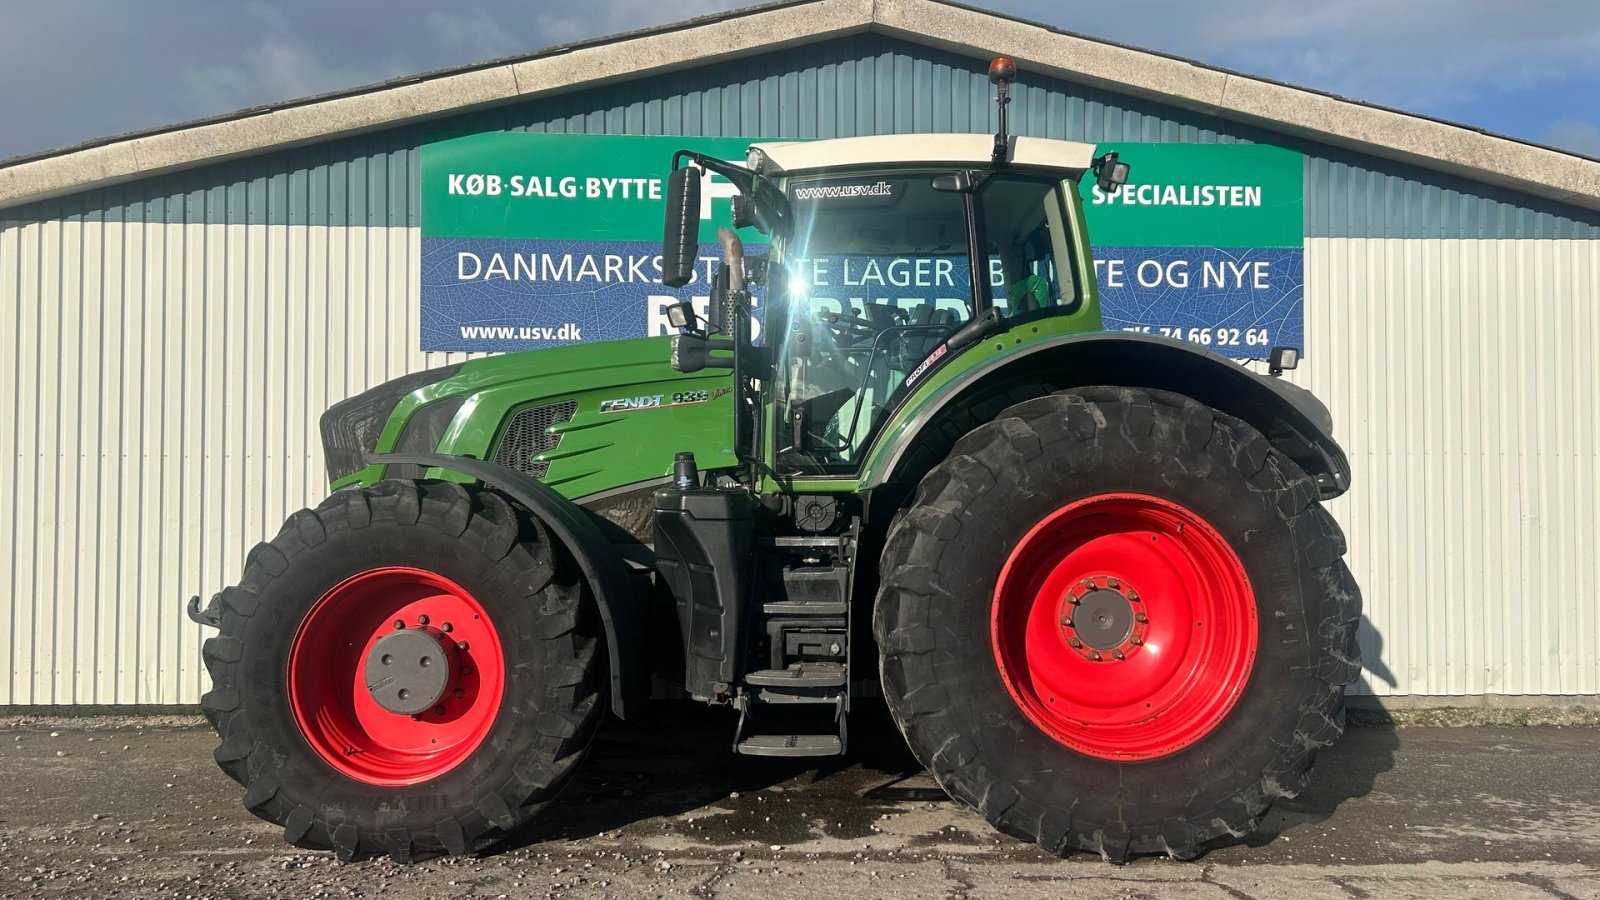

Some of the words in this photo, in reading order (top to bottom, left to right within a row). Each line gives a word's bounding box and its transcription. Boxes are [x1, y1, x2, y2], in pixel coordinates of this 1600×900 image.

[795, 181, 892, 199] www.usv.dk
[1092, 184, 1262, 207] SPECIALISTEN
[843, 258, 954, 287] LAGER
[1137, 259, 1189, 288] OG
[1203, 260, 1270, 289] NYE
[460, 323, 582, 341] www.usv.dk
[1188, 328, 1213, 345] 66
[1217, 328, 1240, 346] 92
[1245, 328, 1269, 346] 64
[600, 394, 665, 413] FENDT
